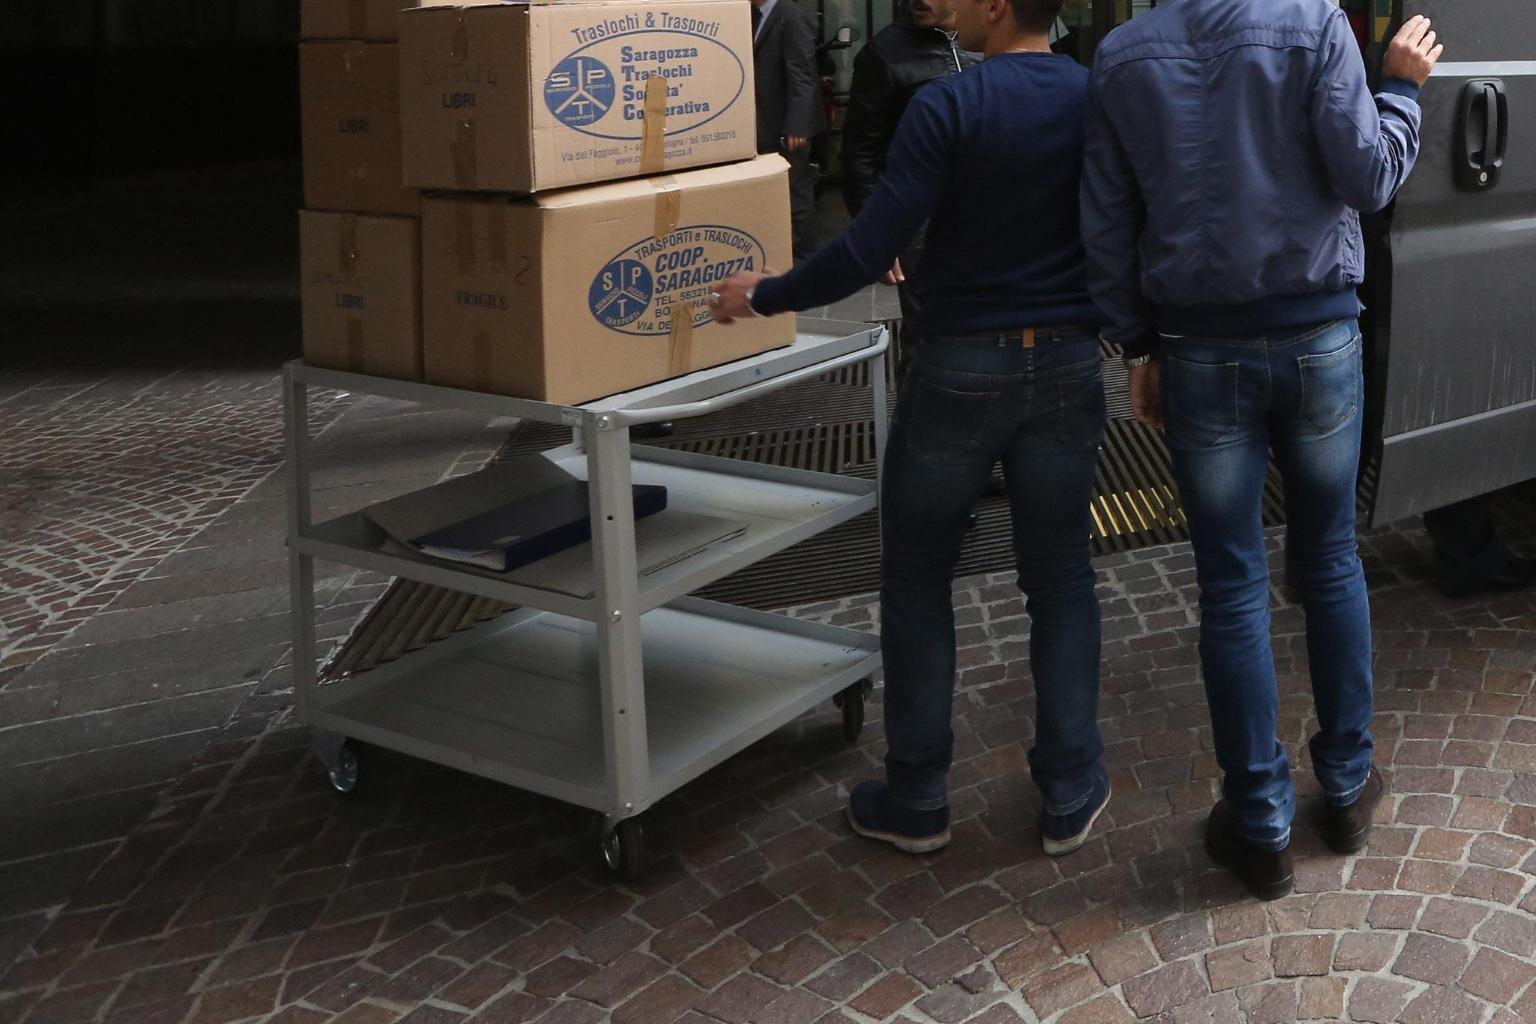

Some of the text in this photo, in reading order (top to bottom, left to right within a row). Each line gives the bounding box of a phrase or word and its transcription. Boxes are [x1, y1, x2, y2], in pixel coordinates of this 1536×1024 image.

[571, 11, 720, 45] Traslochi & Trasporti
[621, 45, 698, 63] Saragozza
[442, 93, 476, 108] LIBRI
[622, 83, 683, 102] Sota'
[622, 101, 710, 121] Coerativa
[635, 231, 692, 261] TRASPORTI
[704, 229, 752, 253] TRASLOCHI
[655, 246, 708, 273] COOP.
[655, 256, 753, 294] SARAGOZZA
[456, 288, 508, 311] FRAGILE
[636, 320, 672, 331] VIA DE
